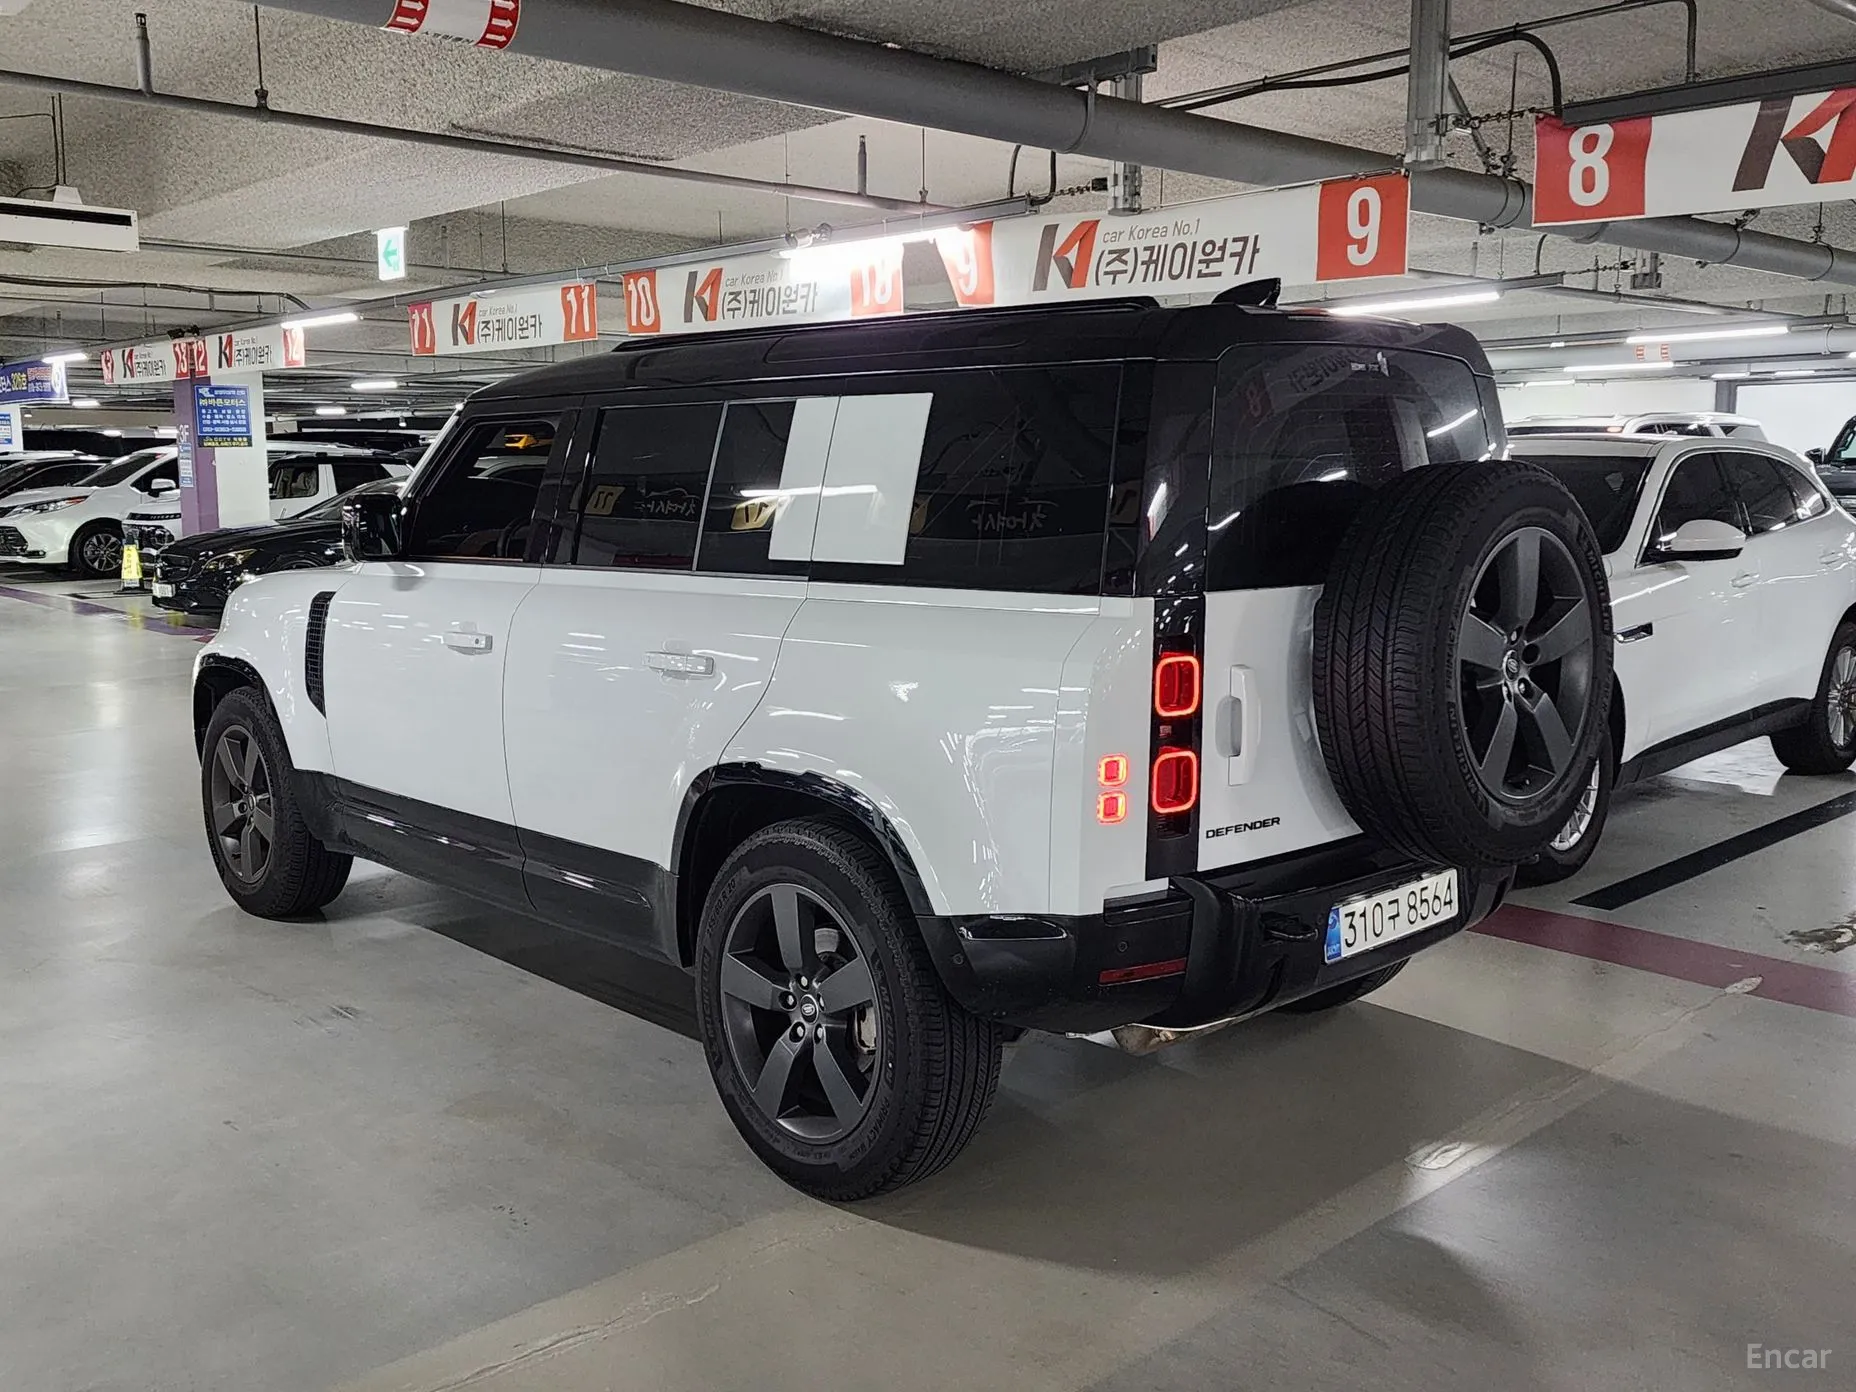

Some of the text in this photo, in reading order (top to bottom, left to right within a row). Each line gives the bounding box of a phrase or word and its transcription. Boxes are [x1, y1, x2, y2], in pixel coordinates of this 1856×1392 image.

[1568, 123, 1615, 206] 8
[1103, 218, 1200, 243] car Korea No.1
[1347, 186, 1381, 266] 9
[725, 277, 739, 288] car
[741, 273, 765, 286] Korea
[1095, 234, 1260, 286] (주)케이원카
[566, 285, 590, 334] 11
[628, 276, 655, 327] 10
[722, 281, 818, 320] (주)케이원카
[412, 308, 431, 349] 11
[477, 314, 542, 344] (주)케이원카
[175, 343, 187, 374] 13
[193, 340, 206, 371] 12
[1205, 817, 1280, 839] DEFENDER
[1344, 874, 1453, 948] 310구 8564
[880, 985, 895, 1087] MICHELN
